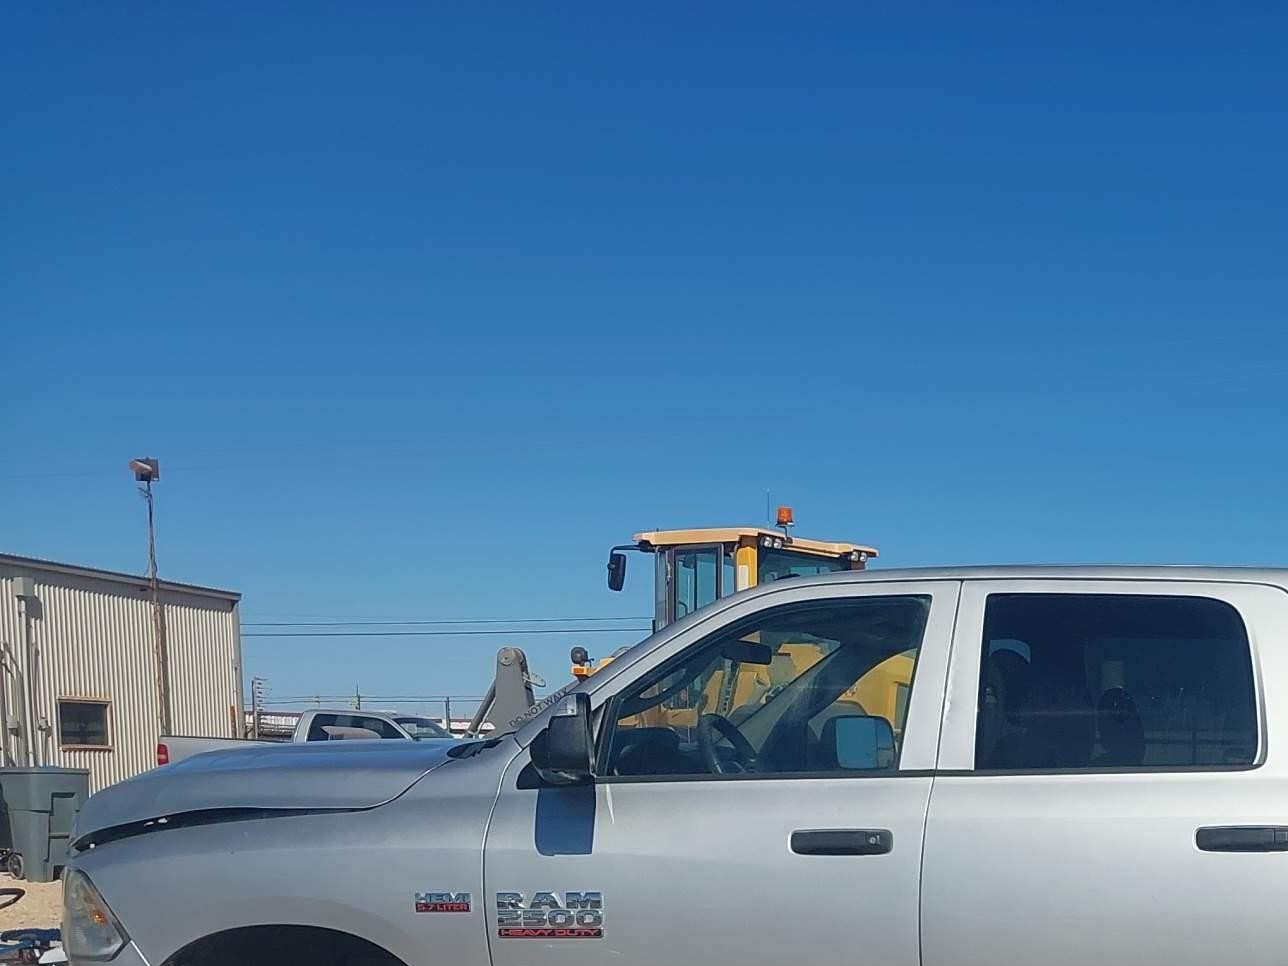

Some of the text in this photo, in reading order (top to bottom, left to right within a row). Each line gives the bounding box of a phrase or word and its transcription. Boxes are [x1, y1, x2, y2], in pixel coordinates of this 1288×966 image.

[509, 687, 569, 727] DO NOT WALK
[415, 892, 472, 903] HEMI
[496, 892, 603, 909] RAM
[437, 904, 469, 912] LITER
[497, 910, 604, 927] 2500
[500, 929, 600, 937] HEAVY DUTY
